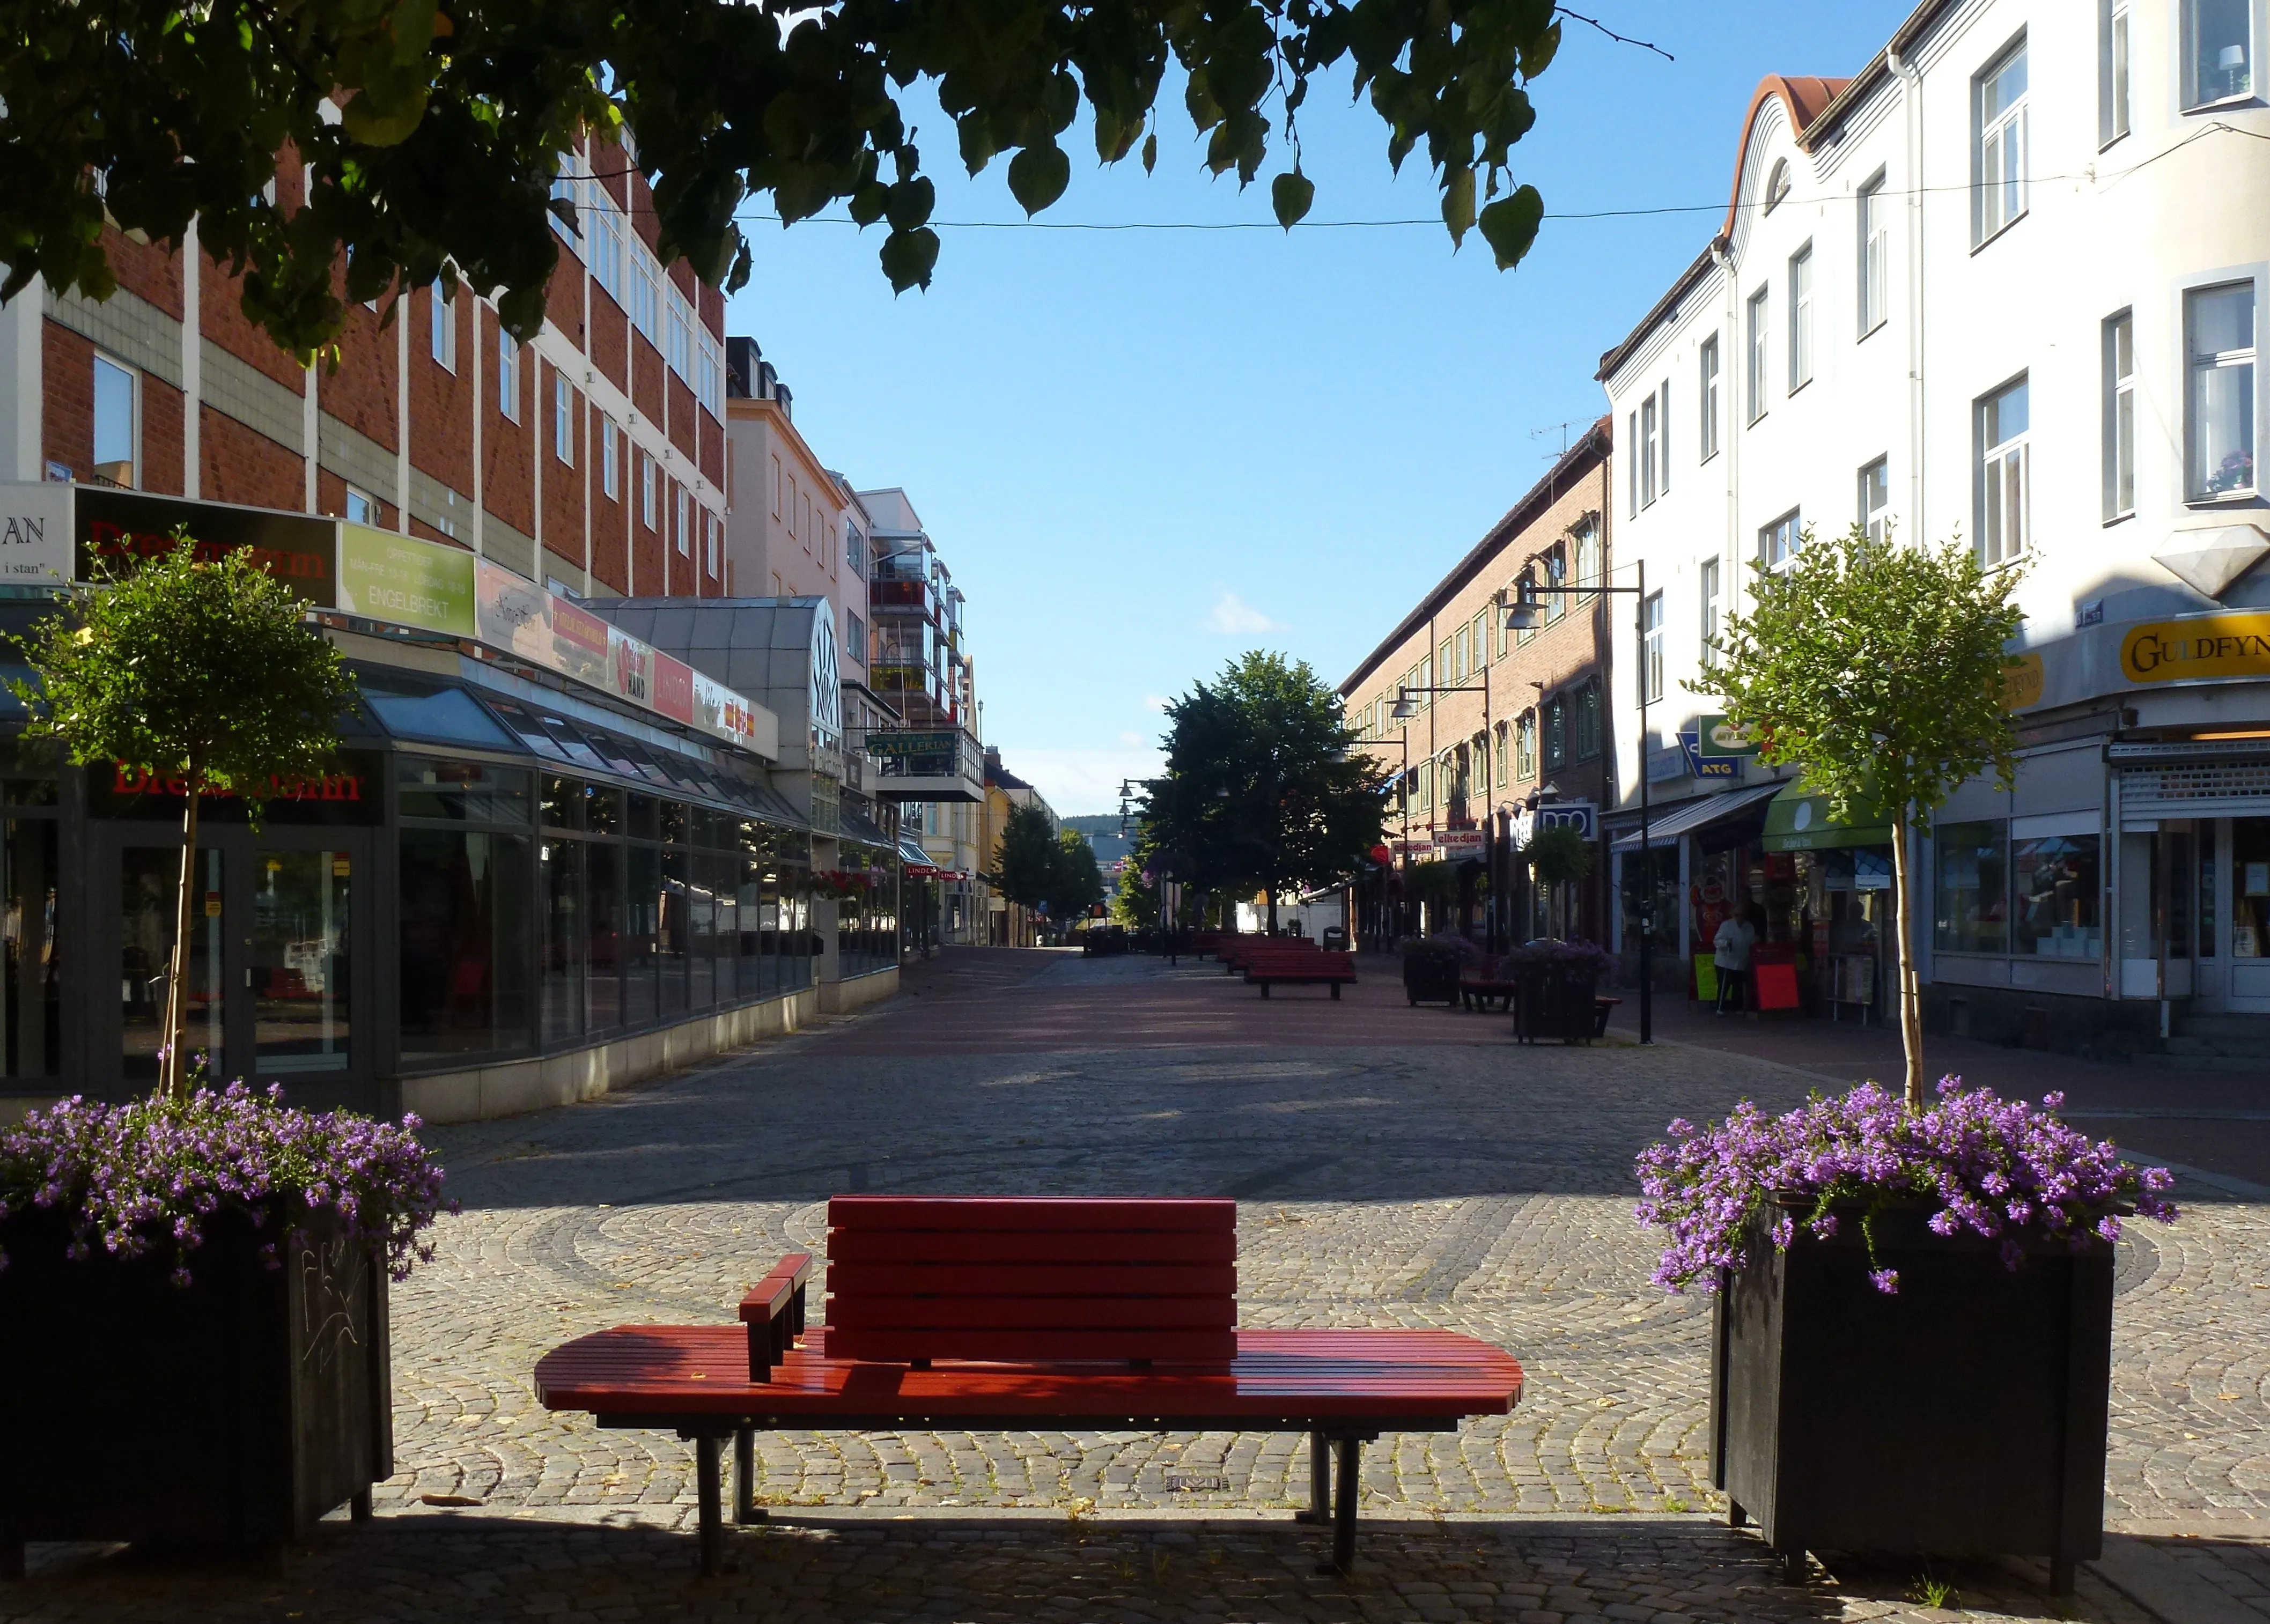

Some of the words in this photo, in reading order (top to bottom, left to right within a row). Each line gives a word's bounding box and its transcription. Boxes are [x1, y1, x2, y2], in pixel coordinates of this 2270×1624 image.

[2, 516, 45, 545] AN
[369, 585, 449, 619] ENGELBREKT
[628, 672, 645, 699] HAND
[868, 740, 952, 756] GALLERIAN
[112, 758, 360, 801] Dreann
[1701, 764, 1733, 774] ATG
[1394, 843, 1432, 852] eledjan
[1438, 833, 1482, 844] elkedjan
